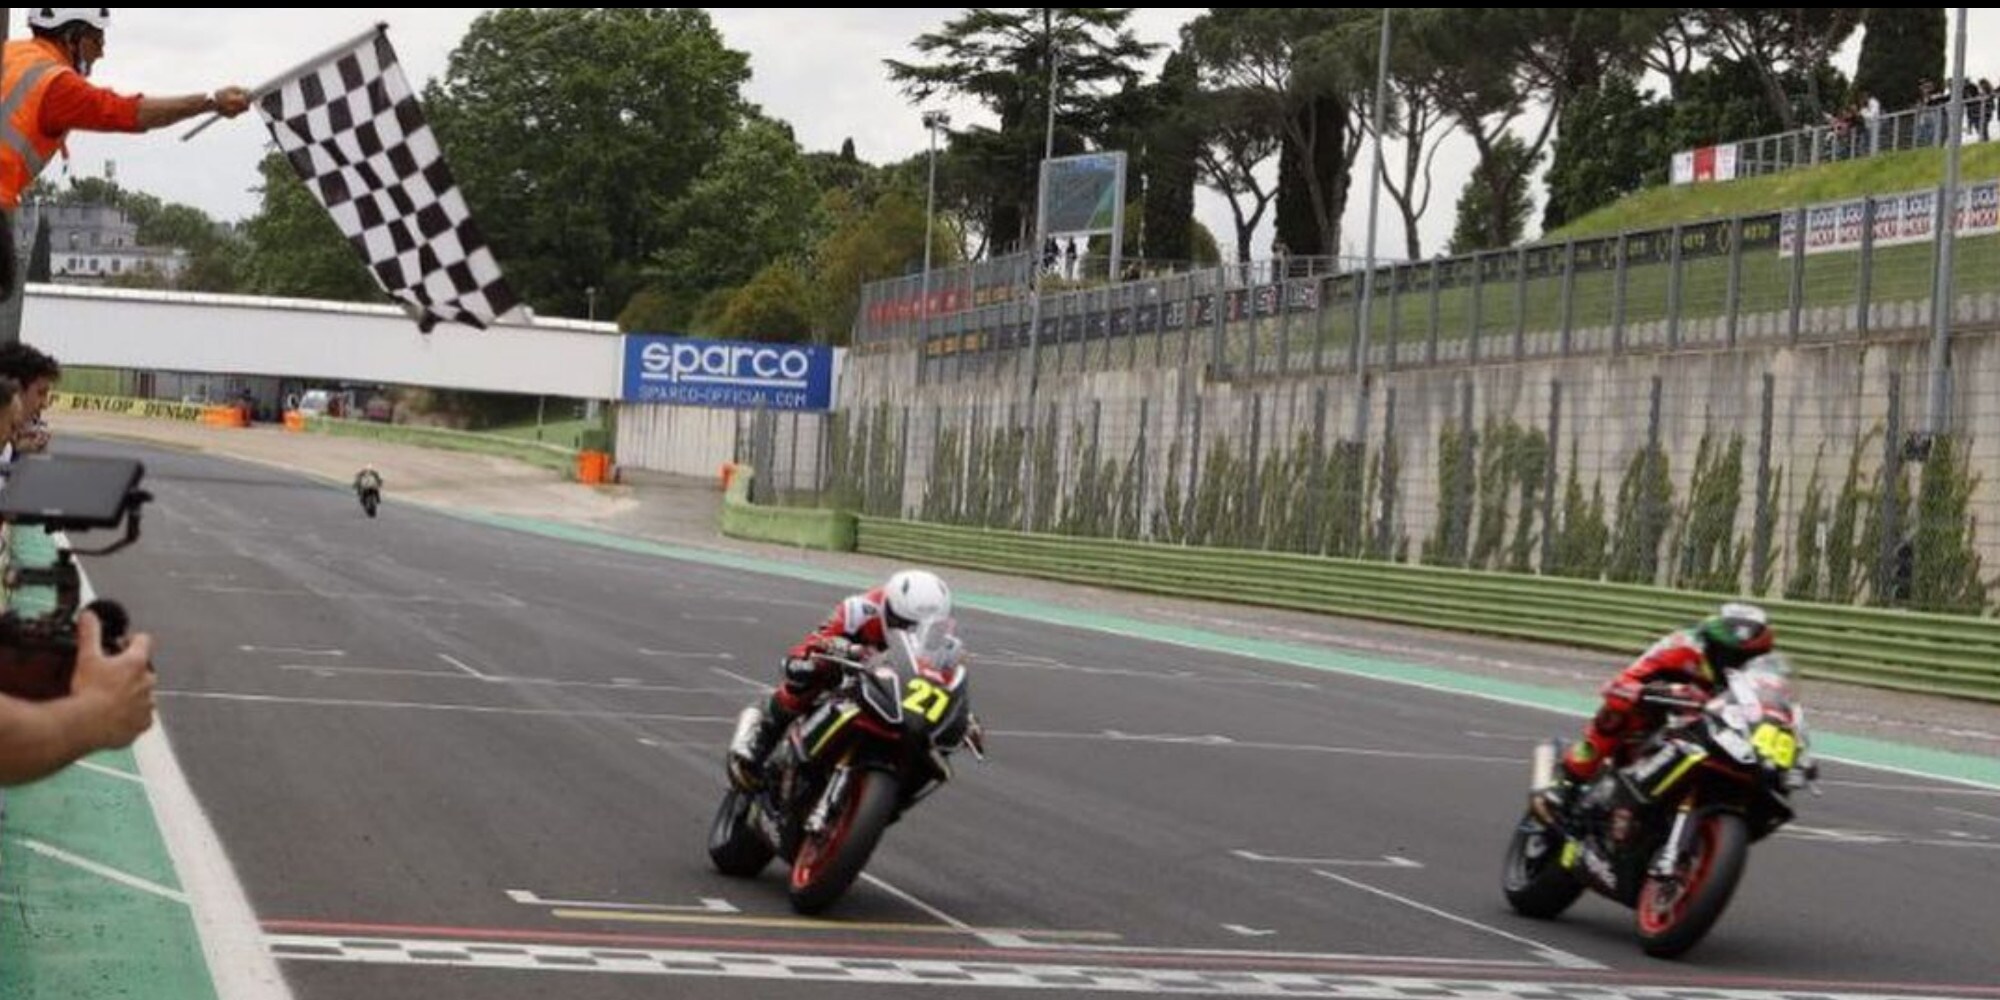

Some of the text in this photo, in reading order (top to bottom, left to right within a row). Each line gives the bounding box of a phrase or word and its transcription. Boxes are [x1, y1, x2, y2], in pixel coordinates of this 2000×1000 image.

[641, 342, 808, 382] sparco
[71, 396, 134, 413] DUNLOP
[143, 402, 202, 421] DUNLOP
[639, 384, 807, 407] SPARCO-OFFICIAL.COM
[902, 678, 949, 723] 27
